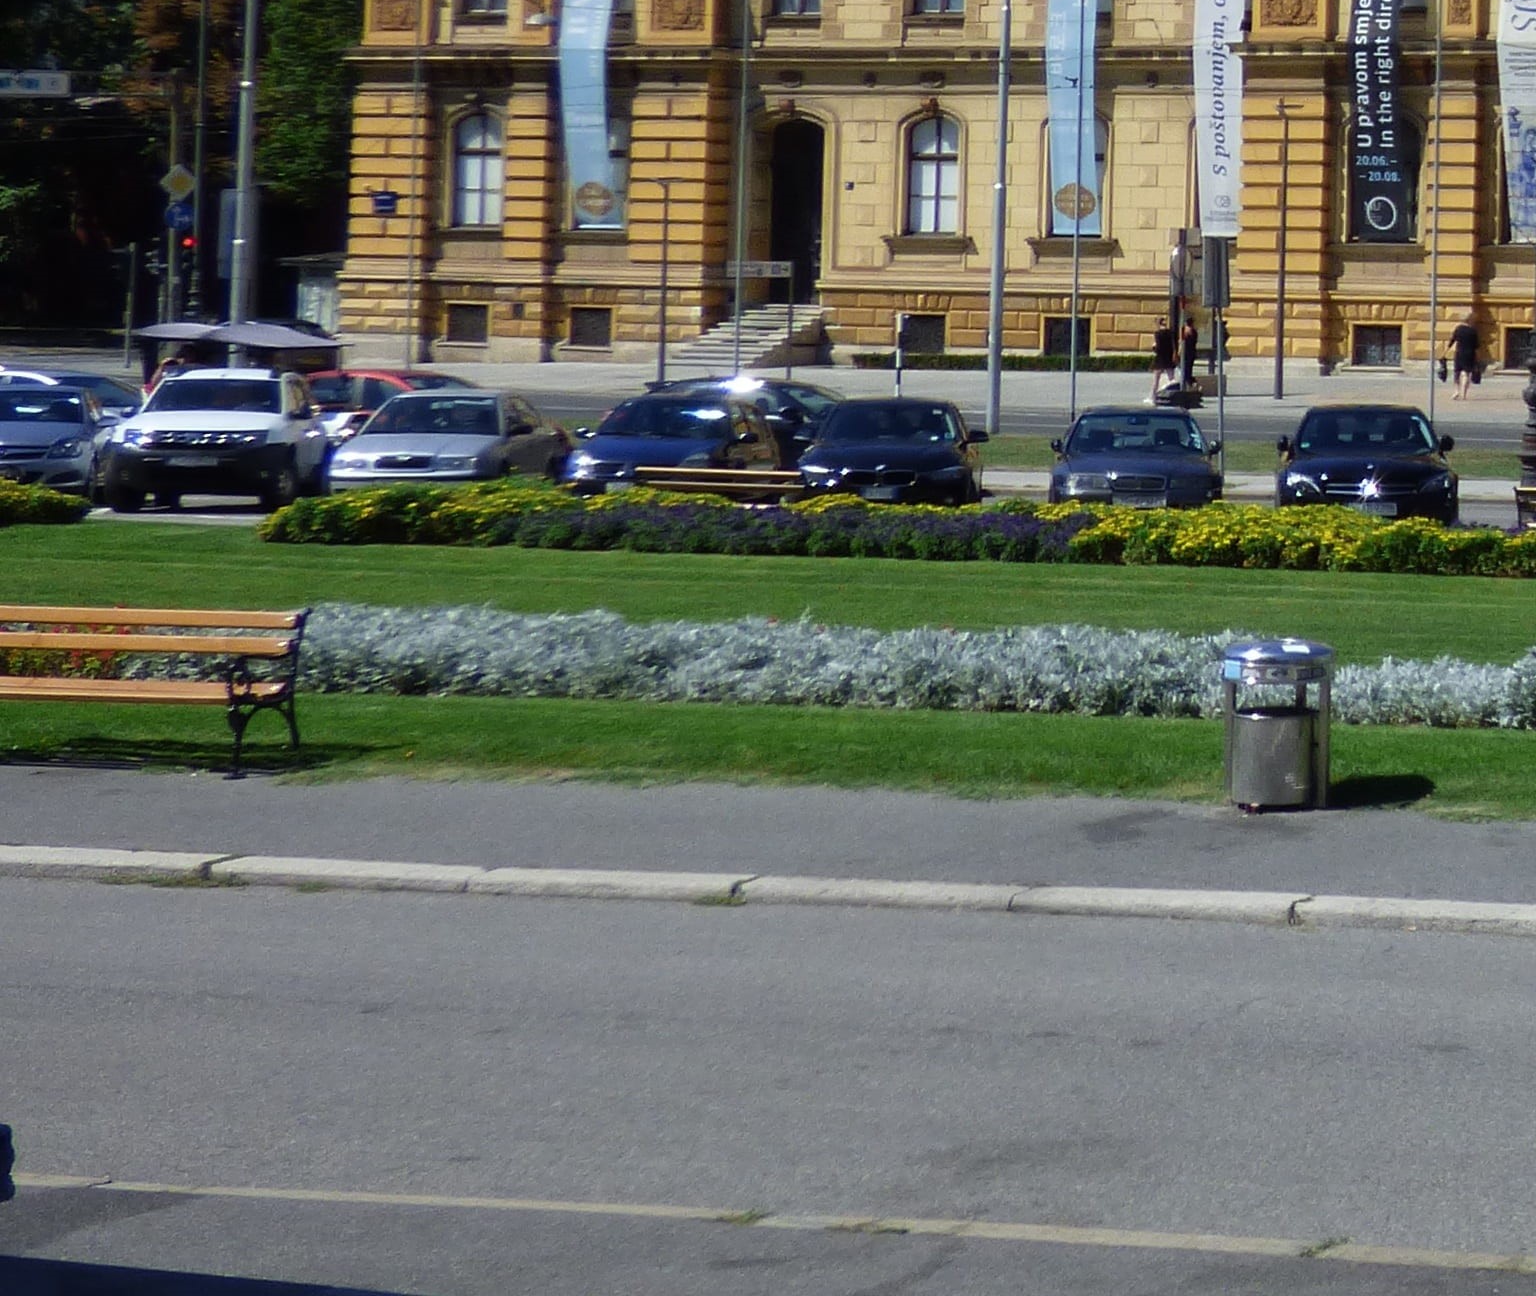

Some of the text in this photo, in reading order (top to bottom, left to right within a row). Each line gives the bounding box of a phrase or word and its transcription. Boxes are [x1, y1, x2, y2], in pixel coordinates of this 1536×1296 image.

[1373, 35, 1395, 84] right
[1207, 15, 1231, 159] poštovanjem,
[1354, 50, 1375, 127] pravom
[1375, 90, 1394, 124] the
[1356, 134, 1373, 148] U
[1379, 129, 1395, 148] In
[1212, 163, 1228, 177] S
